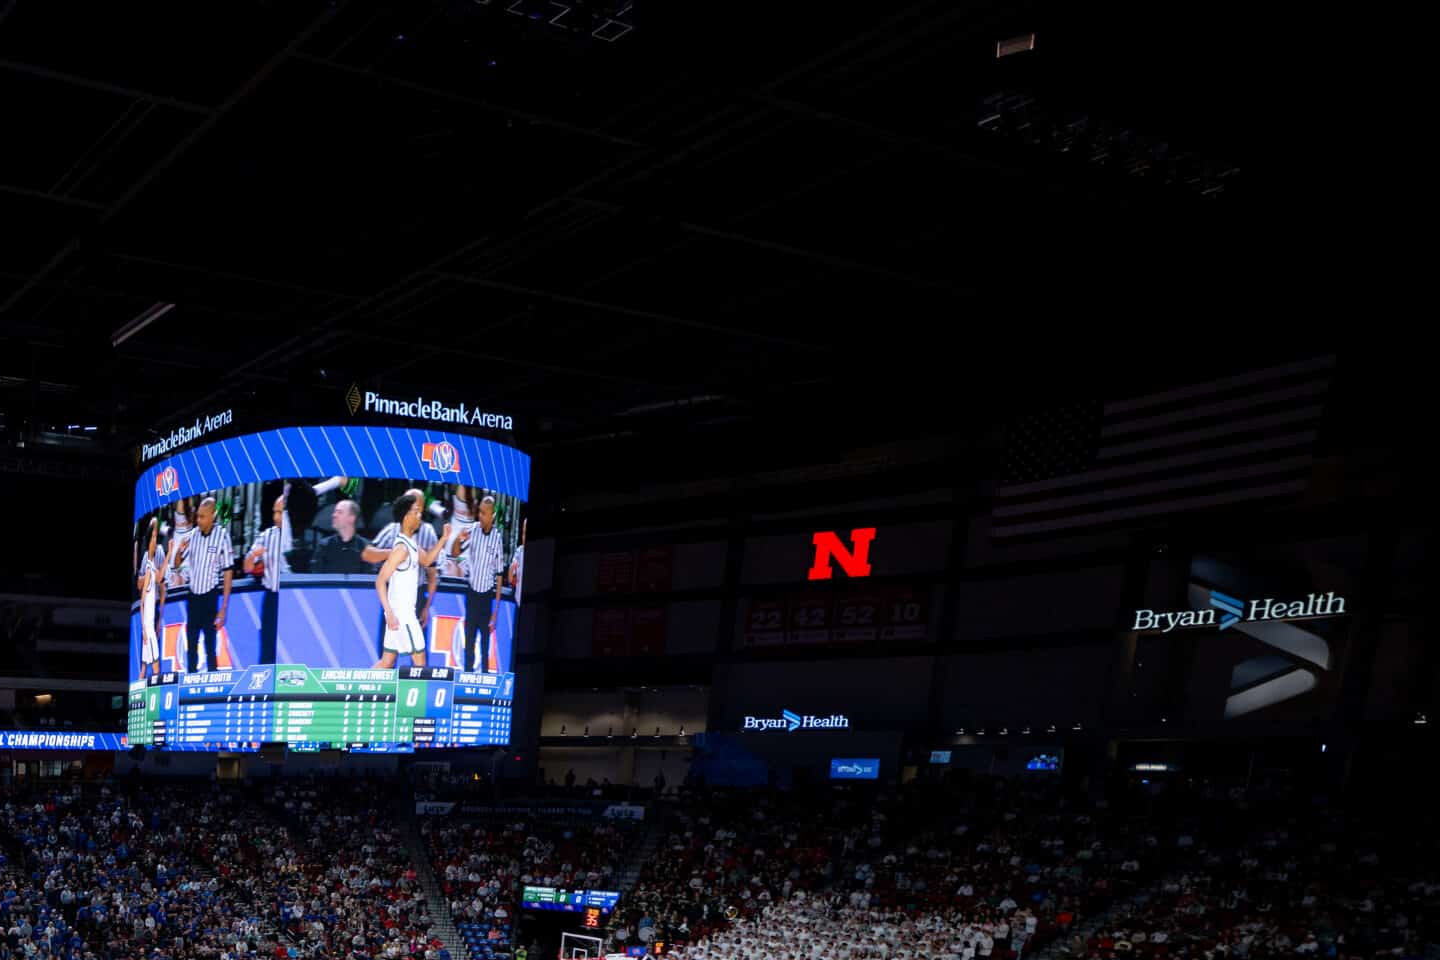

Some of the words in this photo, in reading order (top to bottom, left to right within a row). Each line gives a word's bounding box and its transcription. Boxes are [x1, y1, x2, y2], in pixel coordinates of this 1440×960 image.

[203, 407, 233, 434] Arena
[470, 406, 513, 430] Arena
[808, 527, 877, 580] N
[1132, 605, 1216, 632] Bryan
[1247, 591, 1346, 621] Health
[149, 693, 157, 711] 0
[164, 691, 173, 710] 0
[406, 687, 419, 707] 0
[434, 688, 446, 708] 0
[743, 716, 787, 731] Bryan
[802, 714, 849, 728] Health
[7, 734, 95, 747] CHAMPIONSHIPS
